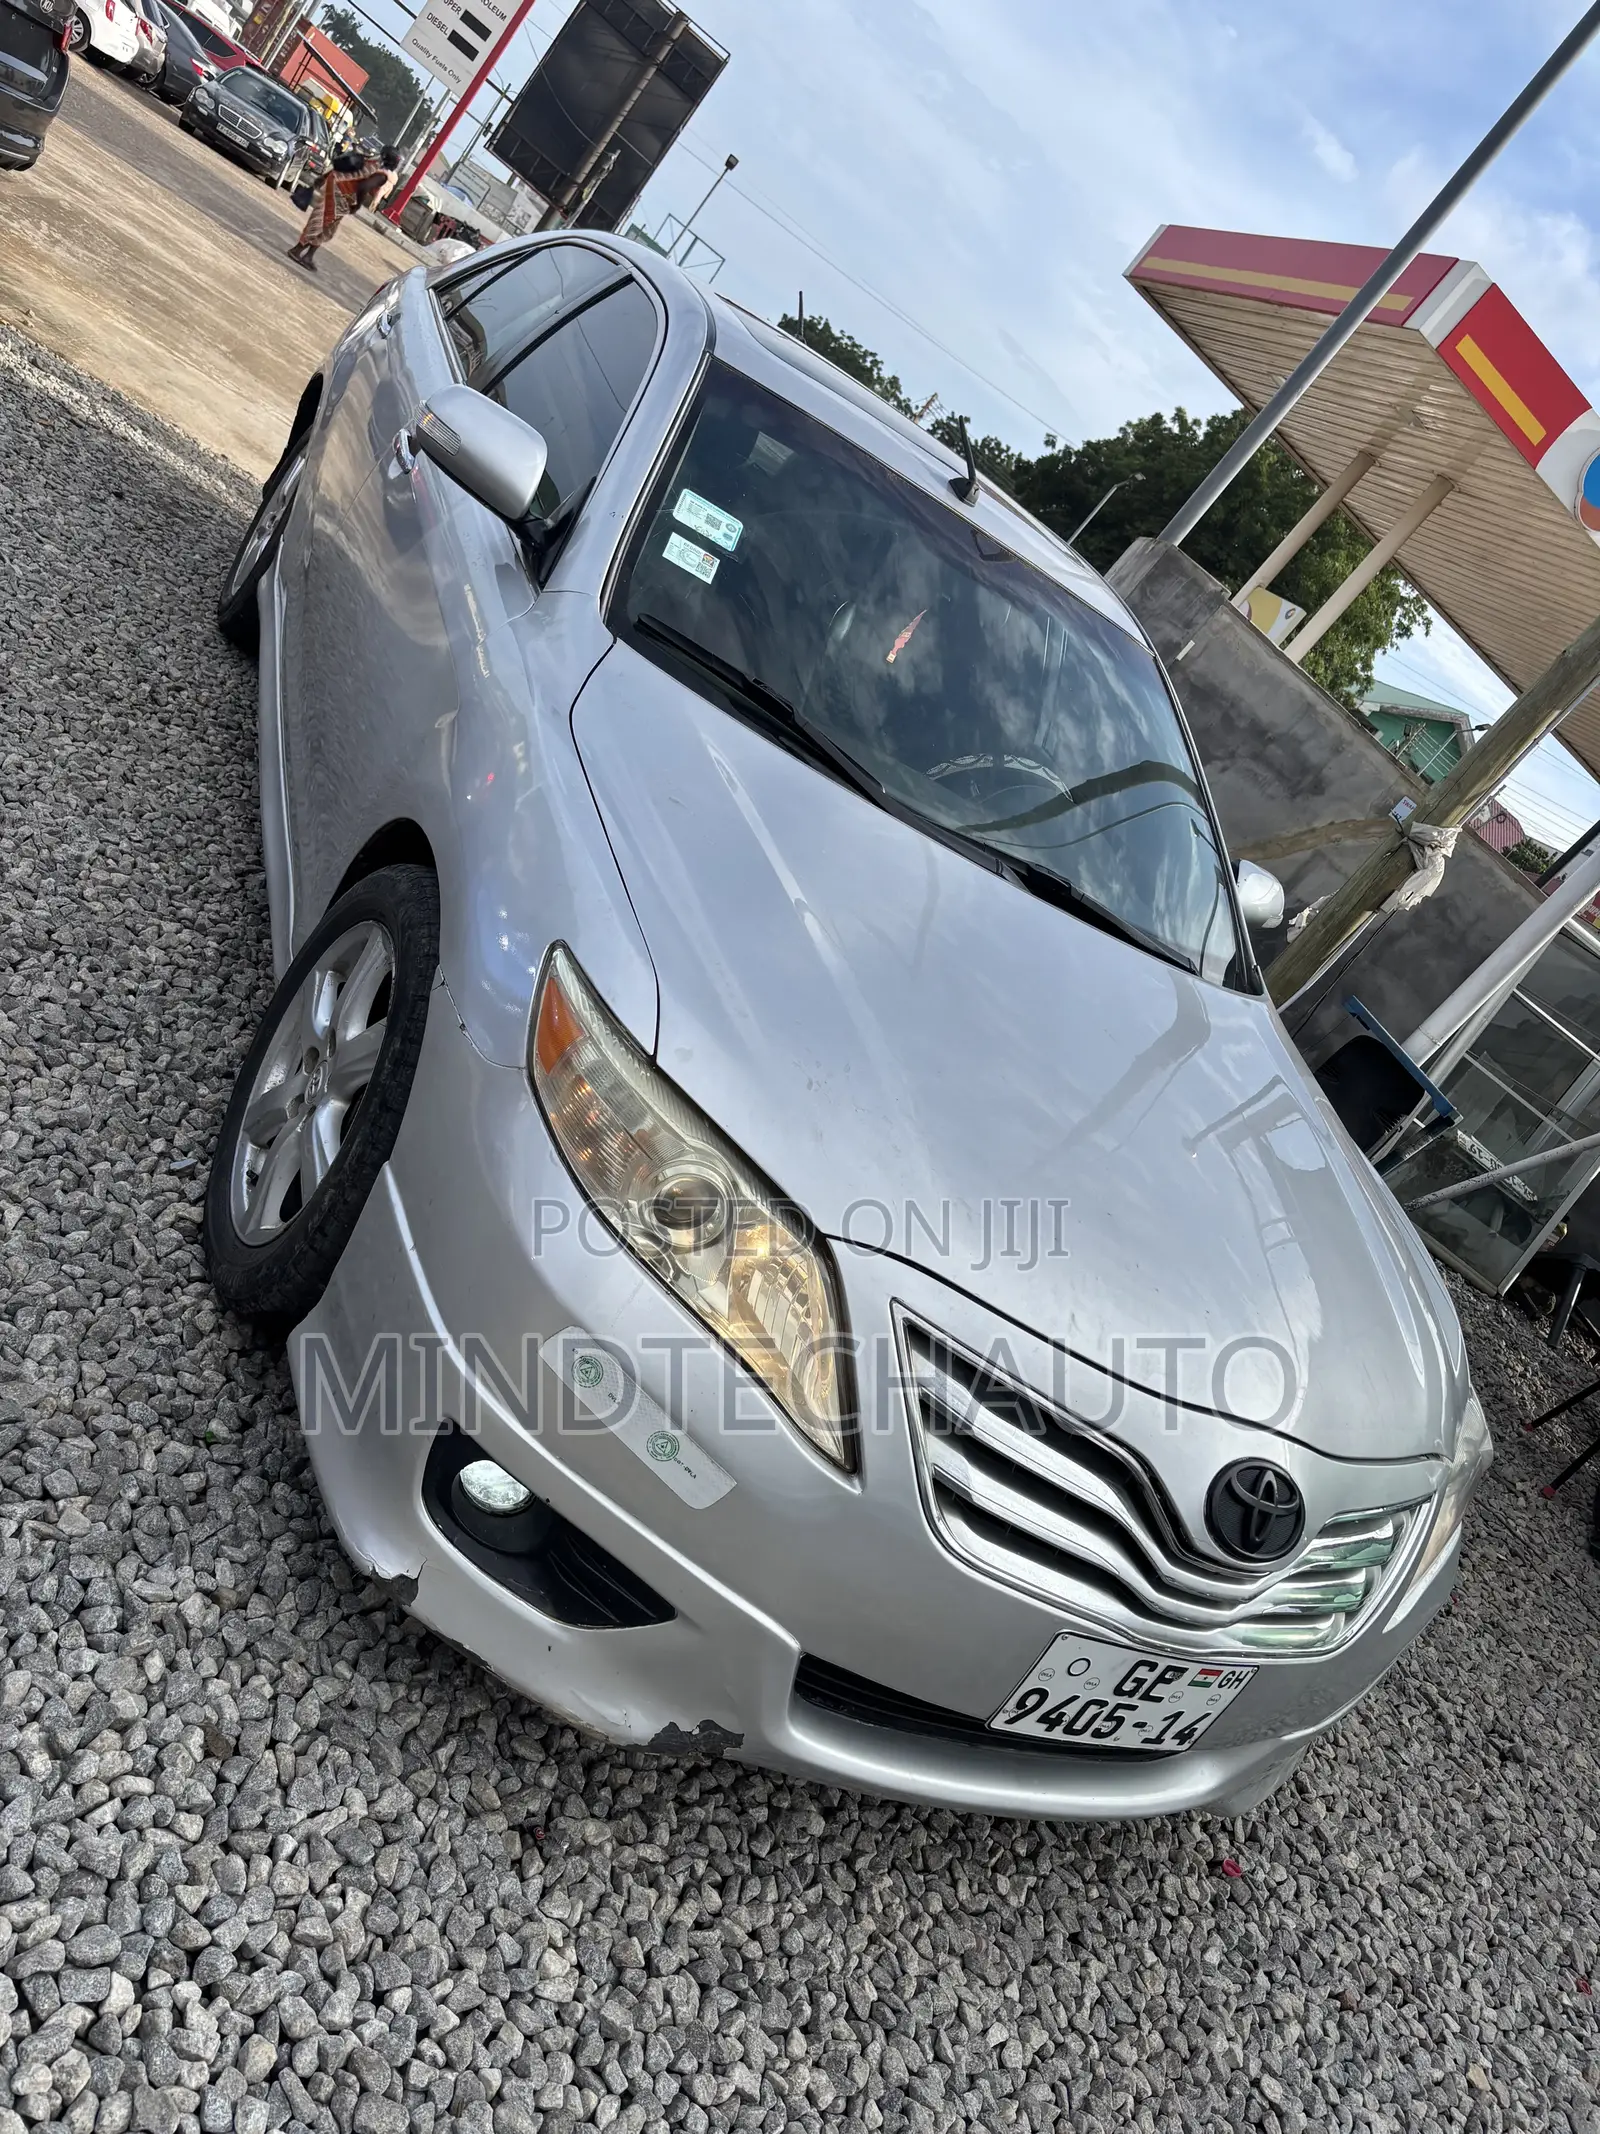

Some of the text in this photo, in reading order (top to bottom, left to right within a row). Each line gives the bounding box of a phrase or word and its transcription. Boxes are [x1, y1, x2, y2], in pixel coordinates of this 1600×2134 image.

[426, 12, 449, 35] DIESEL
[412, 38, 462, 84] Quality Fuels Only
[1113, 1660, 1189, 1703] GE
[1218, 1670, 1250, 1689] GH
[1004, 1687, 1212, 1745] 9405-14
